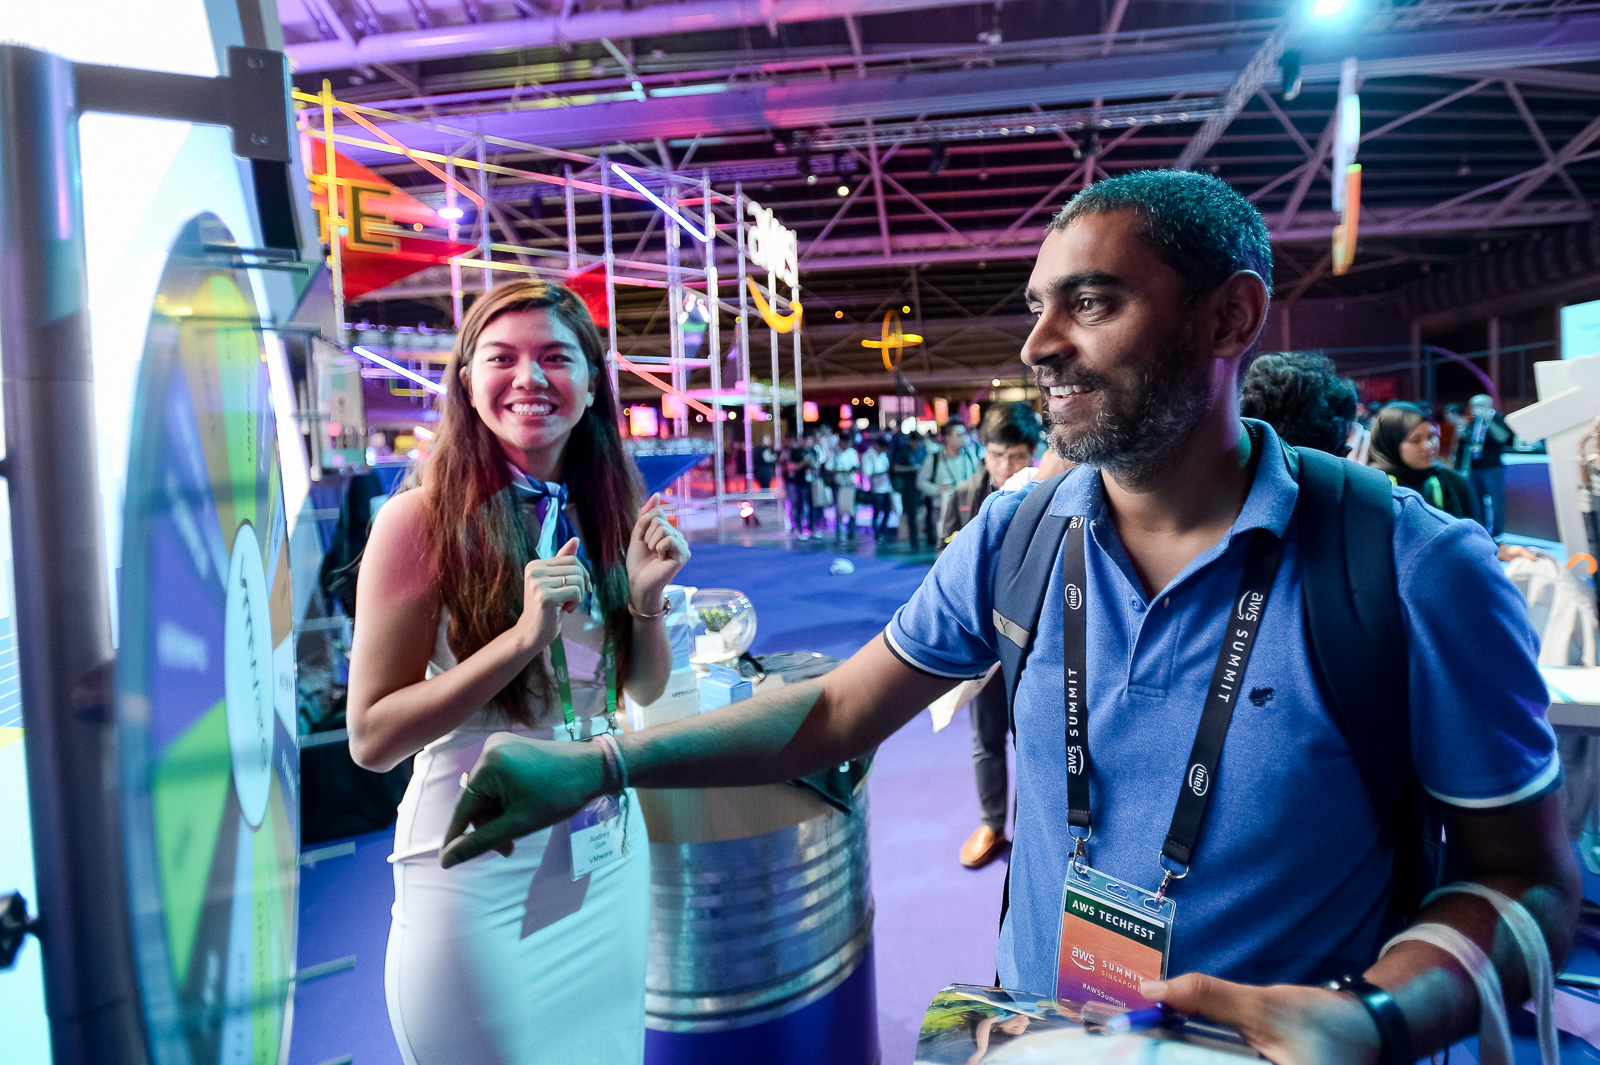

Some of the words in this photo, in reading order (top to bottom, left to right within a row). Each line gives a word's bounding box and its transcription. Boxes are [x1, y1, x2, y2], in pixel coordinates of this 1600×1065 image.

[1068, 587, 1077, 607] intel
[1245, 592, 1264, 622] aws
[1218, 629, 1248, 703] SUMMIT
[1068, 668, 1079, 737] SUMMIT
[1068, 745, 1077, 774] aws
[1193, 768, 1207, 792] intel
[1072, 899, 1095, 916] AWS
[1099, 910, 1155, 941] TECHFEST
[1071, 946, 1095, 965] aws
[1102, 959, 1144, 984] SUMMIT
[1082, 982, 1127, 1009] #AWSSummit
[1101, 970, 1141, 993] SINGAPORE
